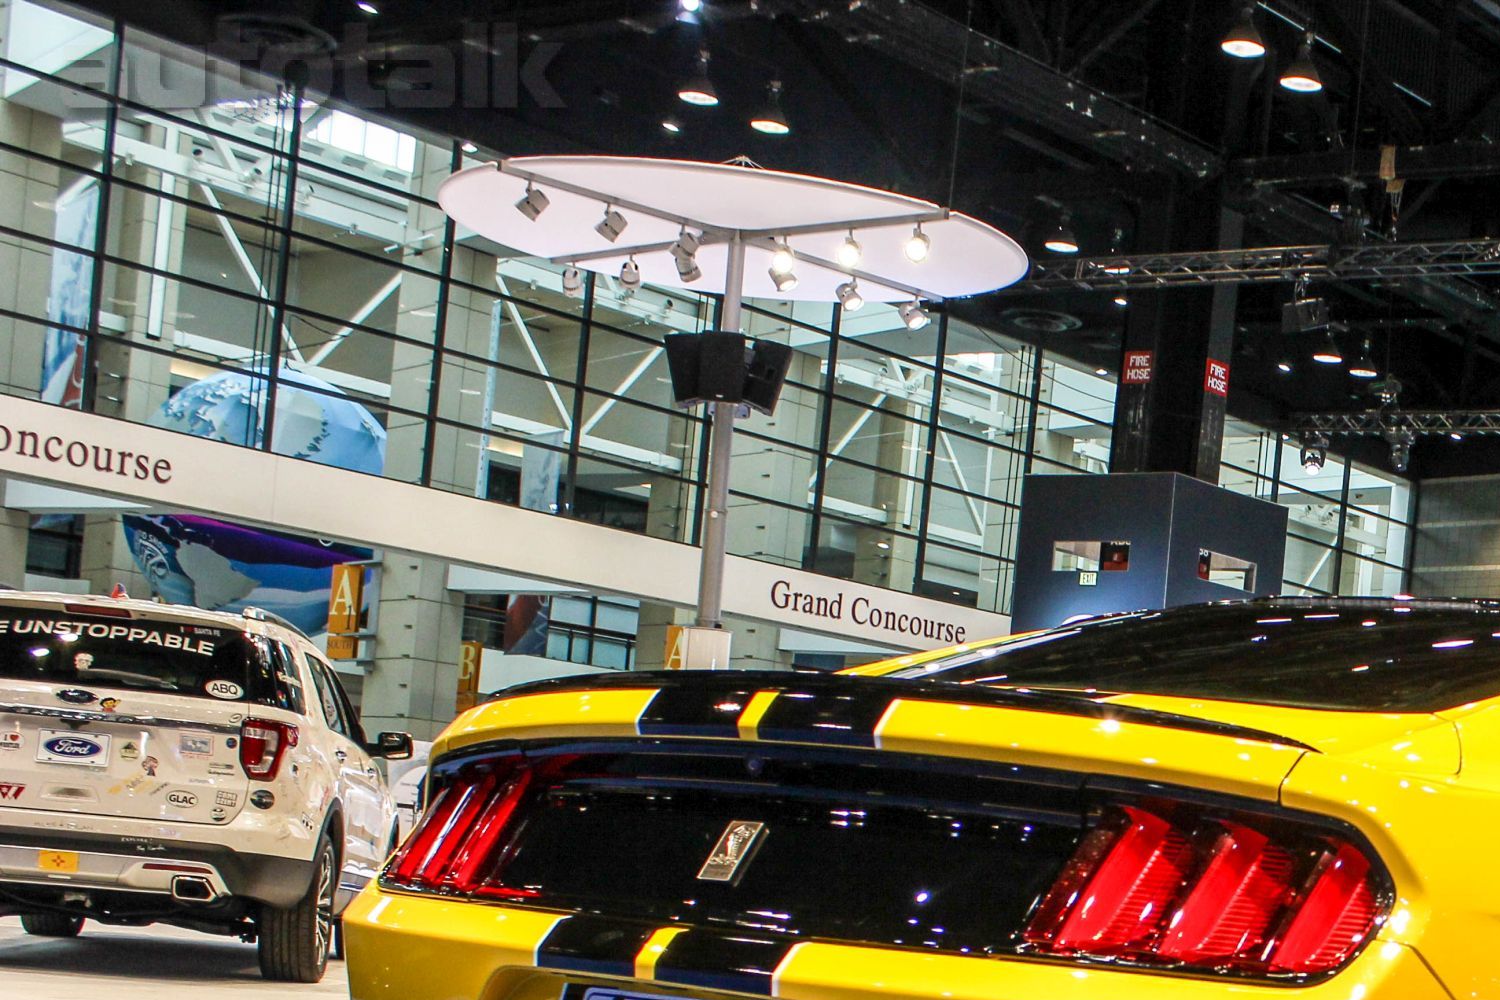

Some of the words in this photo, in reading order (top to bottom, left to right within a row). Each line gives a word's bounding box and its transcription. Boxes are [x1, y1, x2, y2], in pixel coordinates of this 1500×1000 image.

[1129, 355, 1151, 367] FIRE
[1126, 368, 1151, 380] HOSE
[1210, 363, 1226, 380] FIRE
[1207, 376, 1226, 393] HOSE
[1082, 573, 1095, 584] EXIT
[329, 569, 356, 616] A
[771, 580, 843, 620] Grand
[851, 597, 966, 645] Concourse
[13, 619, 215, 657] UNSTOPPABLE
[211, 682, 239, 695] ABQ
[54, 739, 92, 755] Ford
[168, 794, 196, 805] GLAC
